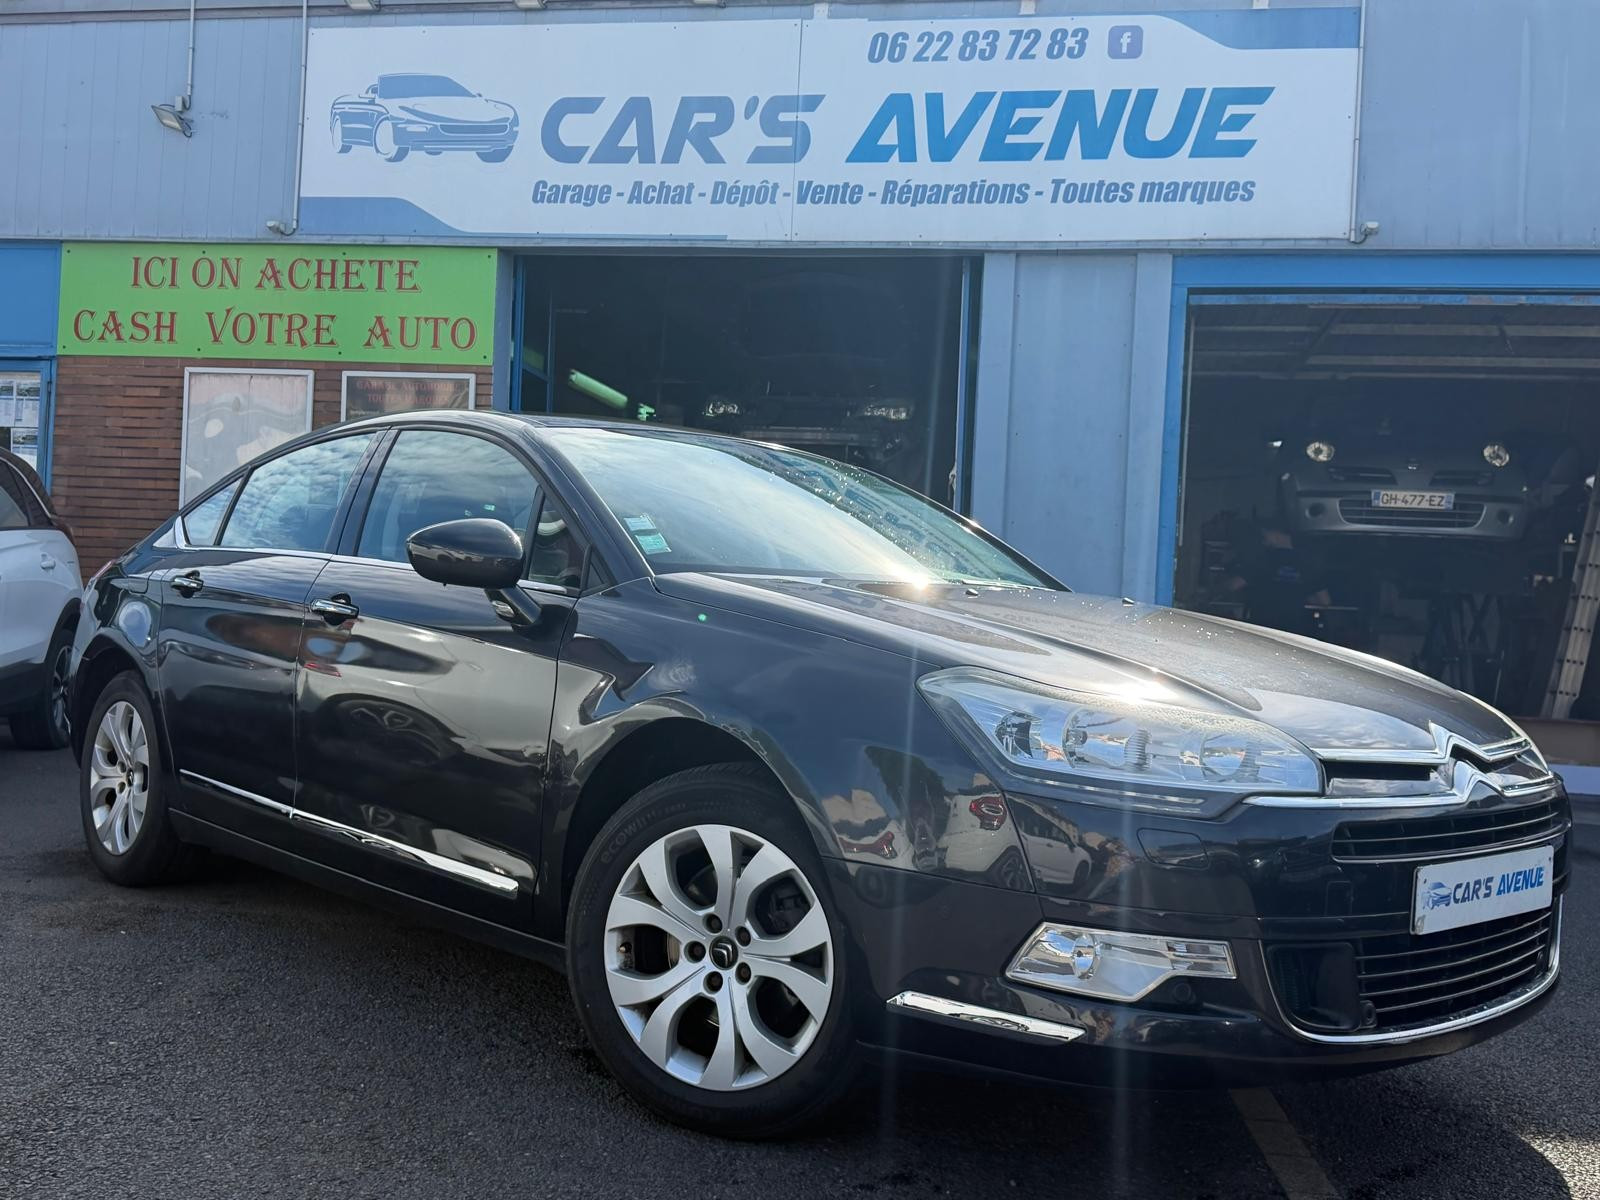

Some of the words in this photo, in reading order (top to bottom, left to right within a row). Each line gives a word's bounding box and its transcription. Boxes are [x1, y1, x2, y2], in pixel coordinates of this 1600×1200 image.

[868, 32, 907, 63] 06
[913, 31, 954, 63] 22
[959, 30, 1000, 62] 83
[1006, 29, 1046, 61] 72
[1048, 28, 1089, 60] 83
[541, 94, 826, 164] CAR'S
[845, 87, 1275, 163] AVENUE
[532, 180, 612, 207] Garage
[627, 181, 695, 205] Achat
[710, 180, 780, 207] Dépôt
[797, 181, 863, 204] Vente
[881, 179, 1030, 207] Réparations
[1051, 179, 1136, 204] Toutes
[1138, 180, 1256, 206] marques
[131, 256, 179, 289] ICI
[192, 256, 241, 289] ON
[256, 258, 420, 292] ACHETE
[73, 309, 177, 344] CASH
[207, 306, 337, 349] VOTRE
[364, 315, 477, 351] AUTO
[1381, 493, 1445, 507] GH-477-EZ
[1453, 876, 1494, 904] CAR'S
[1496, 866, 1545, 896] AVENUE
